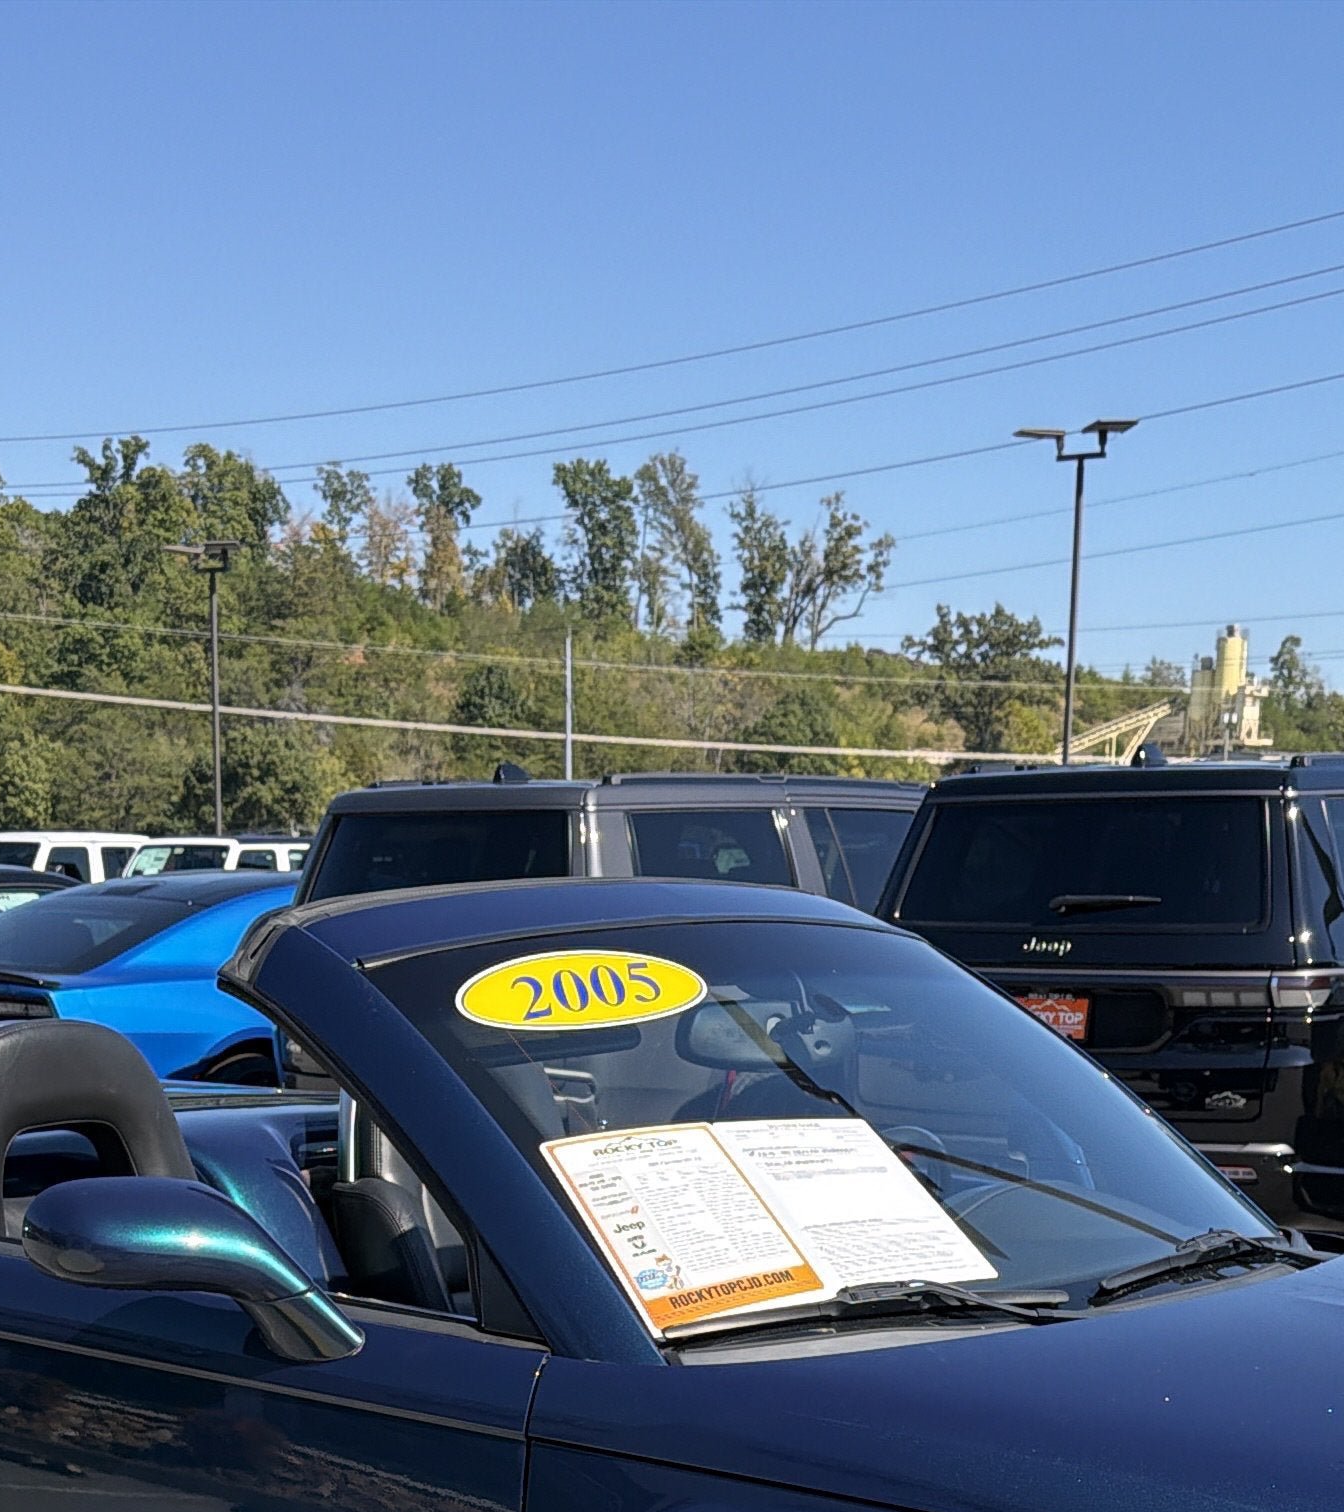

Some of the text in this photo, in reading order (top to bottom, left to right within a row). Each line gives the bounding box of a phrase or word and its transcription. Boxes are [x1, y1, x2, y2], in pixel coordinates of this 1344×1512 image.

[510, 962, 661, 1021] 2005
[1058, 1011, 1084, 1025] TOP
[613, 1220, 646, 1235] Jeep
[668, 1269, 796, 1310] ROCKYTOPCJD.COM
